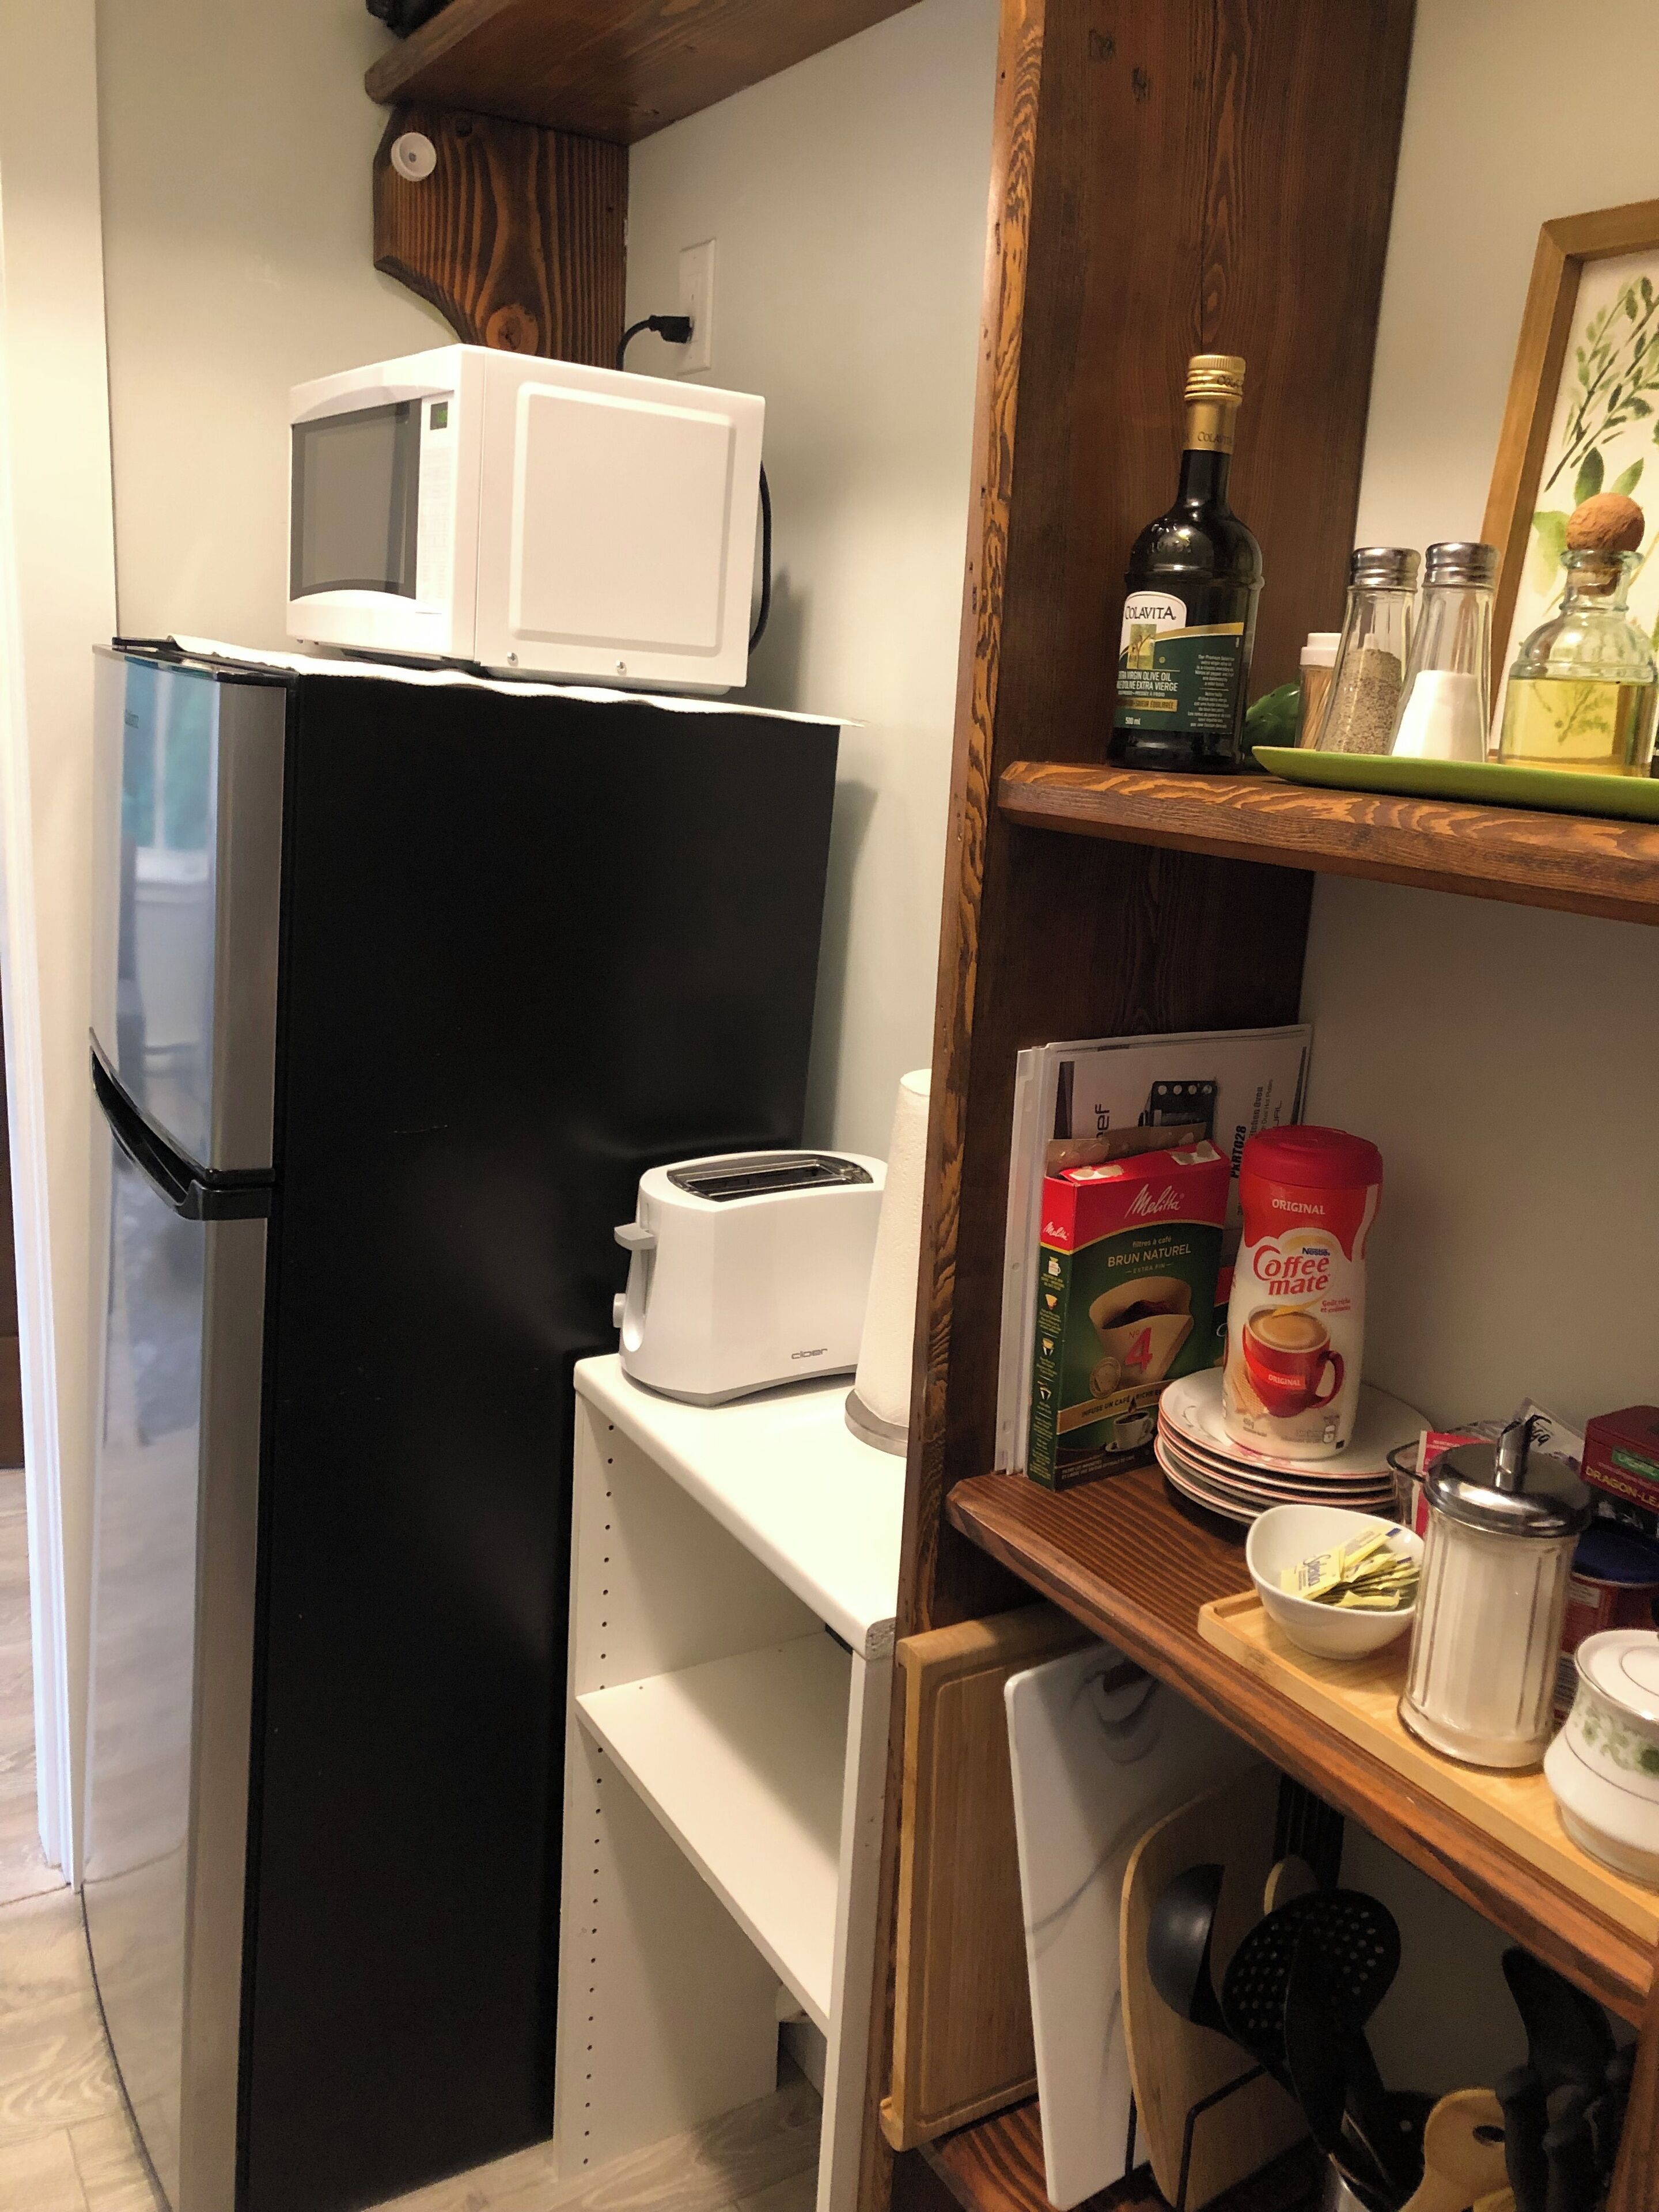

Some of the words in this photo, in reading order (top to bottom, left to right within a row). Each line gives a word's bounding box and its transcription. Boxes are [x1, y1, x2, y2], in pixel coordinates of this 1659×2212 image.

[1126, 606, 1174, 620] COLAVITA
[1143, 672, 1160, 681] OLIVE
[1161, 673, 1172, 681] OIL
[1137, 681, 1154, 690] EXTRA
[1155, 683, 1179, 692] VIERGE
[1253, 1086, 1263, 1108] Oven
[1124, 1184, 1180, 1218] Melitta
[1272, 1199, 1325, 1215] ORIGINAL
[1133, 1239, 1151, 1248] filtres
[1158, 1236, 1172, 1244] café
[1108, 1253, 1140, 1267] BRUN
[1143, 1244, 1191, 1261] NATUREL
[1252, 1245, 1330, 1281] Coffee
[1133, 1266, 1153, 1274] EXTRA
[1268, 1275, 1328, 1296] mate
[791, 1349, 828, 1359] cloer
[1124, 1327, 1153, 1370] 4
[1268, 1374, 1302, 1386] ORIGINAL
